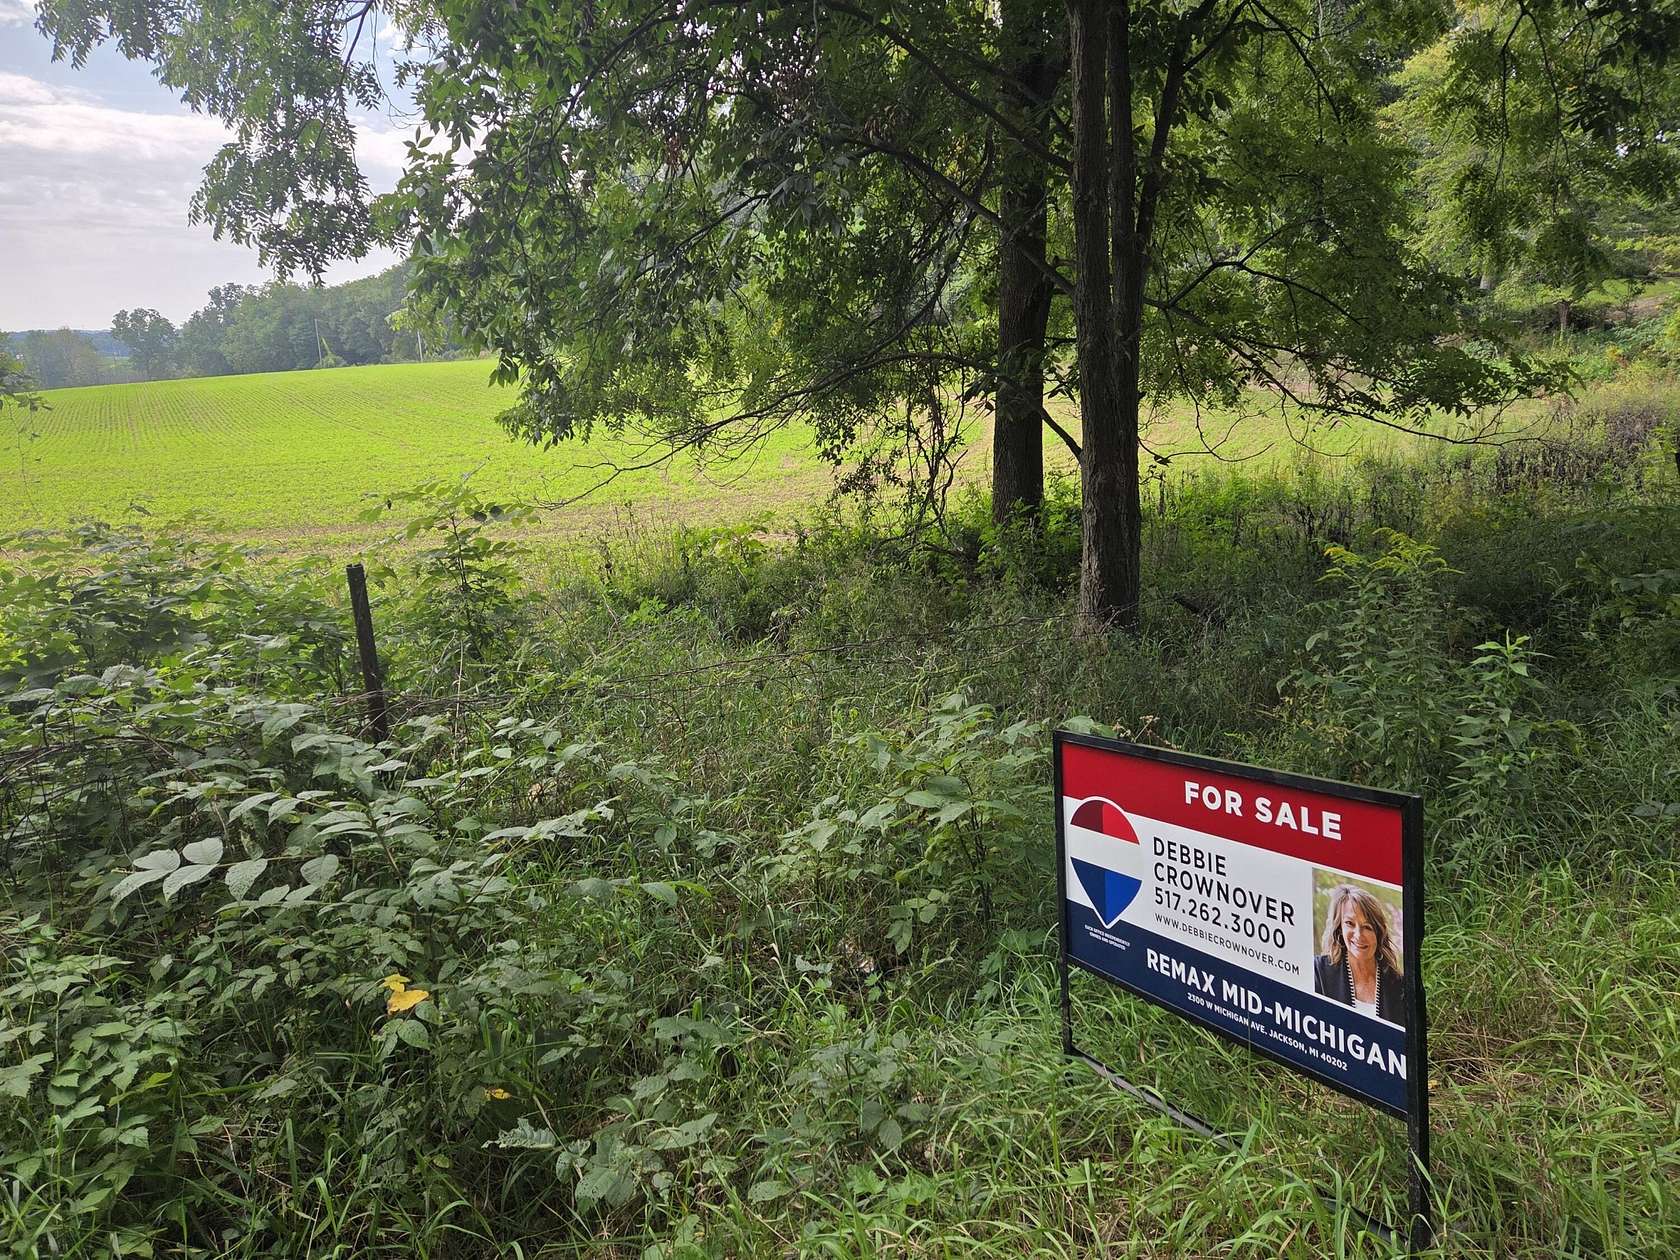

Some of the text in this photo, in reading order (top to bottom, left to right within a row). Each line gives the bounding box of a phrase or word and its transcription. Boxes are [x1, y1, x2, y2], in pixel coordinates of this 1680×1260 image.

[1184, 780, 1342, 841] FOR SALE
[1153, 836, 1227, 877] DEBBIE
[1154, 862, 1295, 926] CROWNOVER
[1155, 886, 1286, 949] 517.262.3000
[1155, 913, 1300, 975] WWW.DEBBIECROWNOVER.COM
[1146, 948, 1407, 1080] REMAX MID-MICHIGAN
[1205, 1000, 1214, 1010] W
[1214, 1003, 1249, 1027] MICHIGAN
[1269, 1029, 1308, 1054] JACKSON,
[1309, 1046, 1319, 1058] MI
